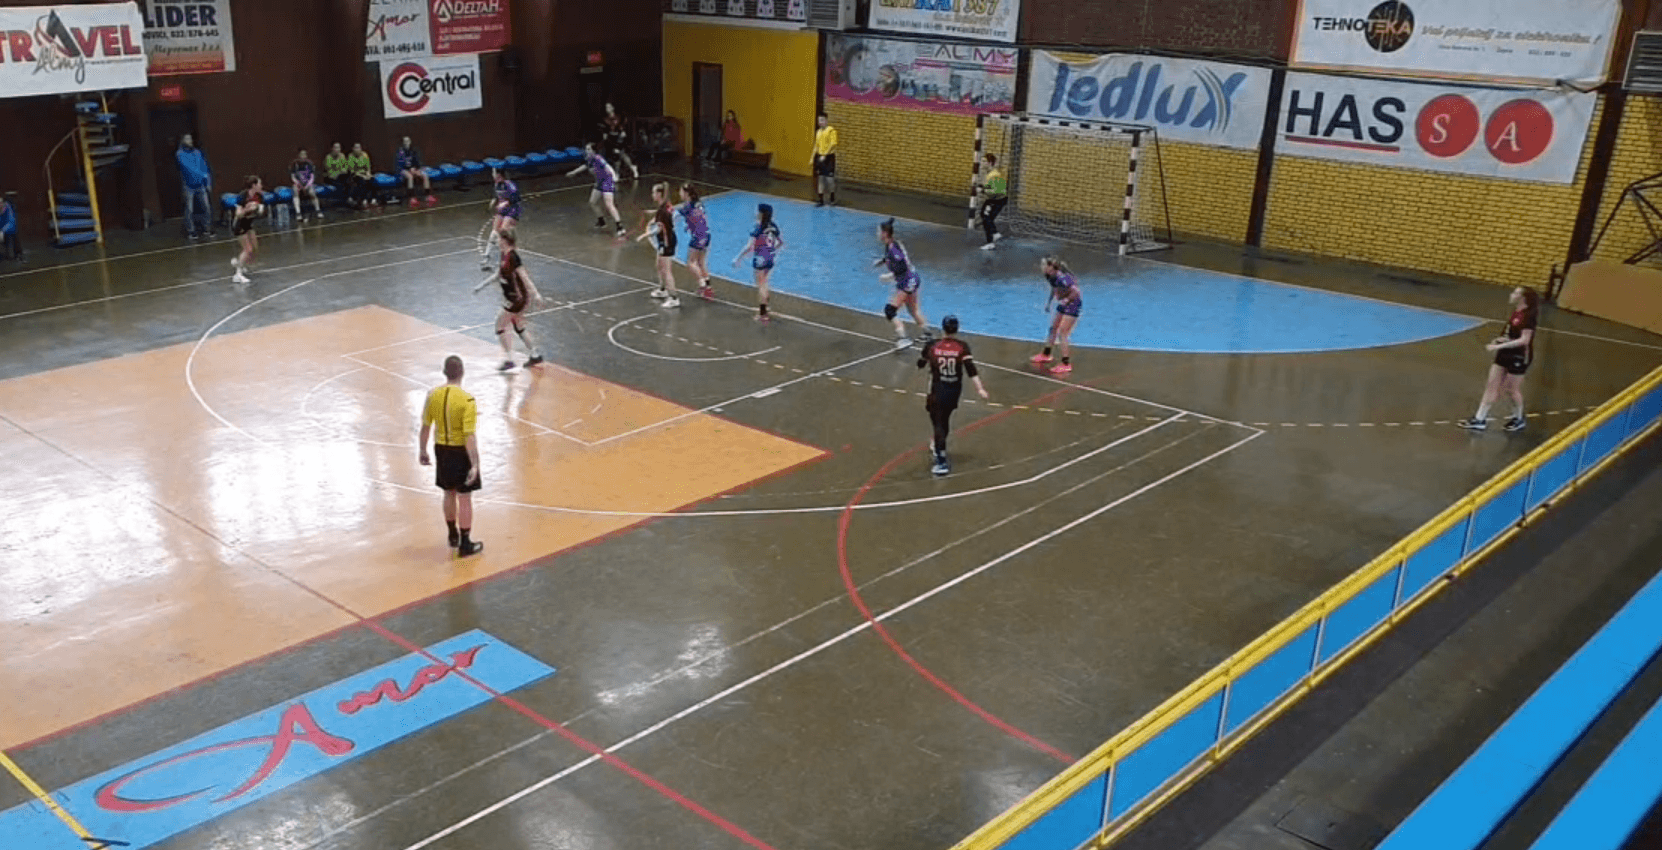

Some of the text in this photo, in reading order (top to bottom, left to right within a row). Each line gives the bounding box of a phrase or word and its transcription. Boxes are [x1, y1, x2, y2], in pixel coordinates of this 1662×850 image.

[143, 5, 217, 28] LIDER
[1313, 17, 1411, 34] TEHNOTEKA
[1048, 61, 1248, 134] ledlux
[1286, 89, 1521, 152] HAS S A
[938, 357, 957, 376] 20
[95, 643, 490, 812] Amor
